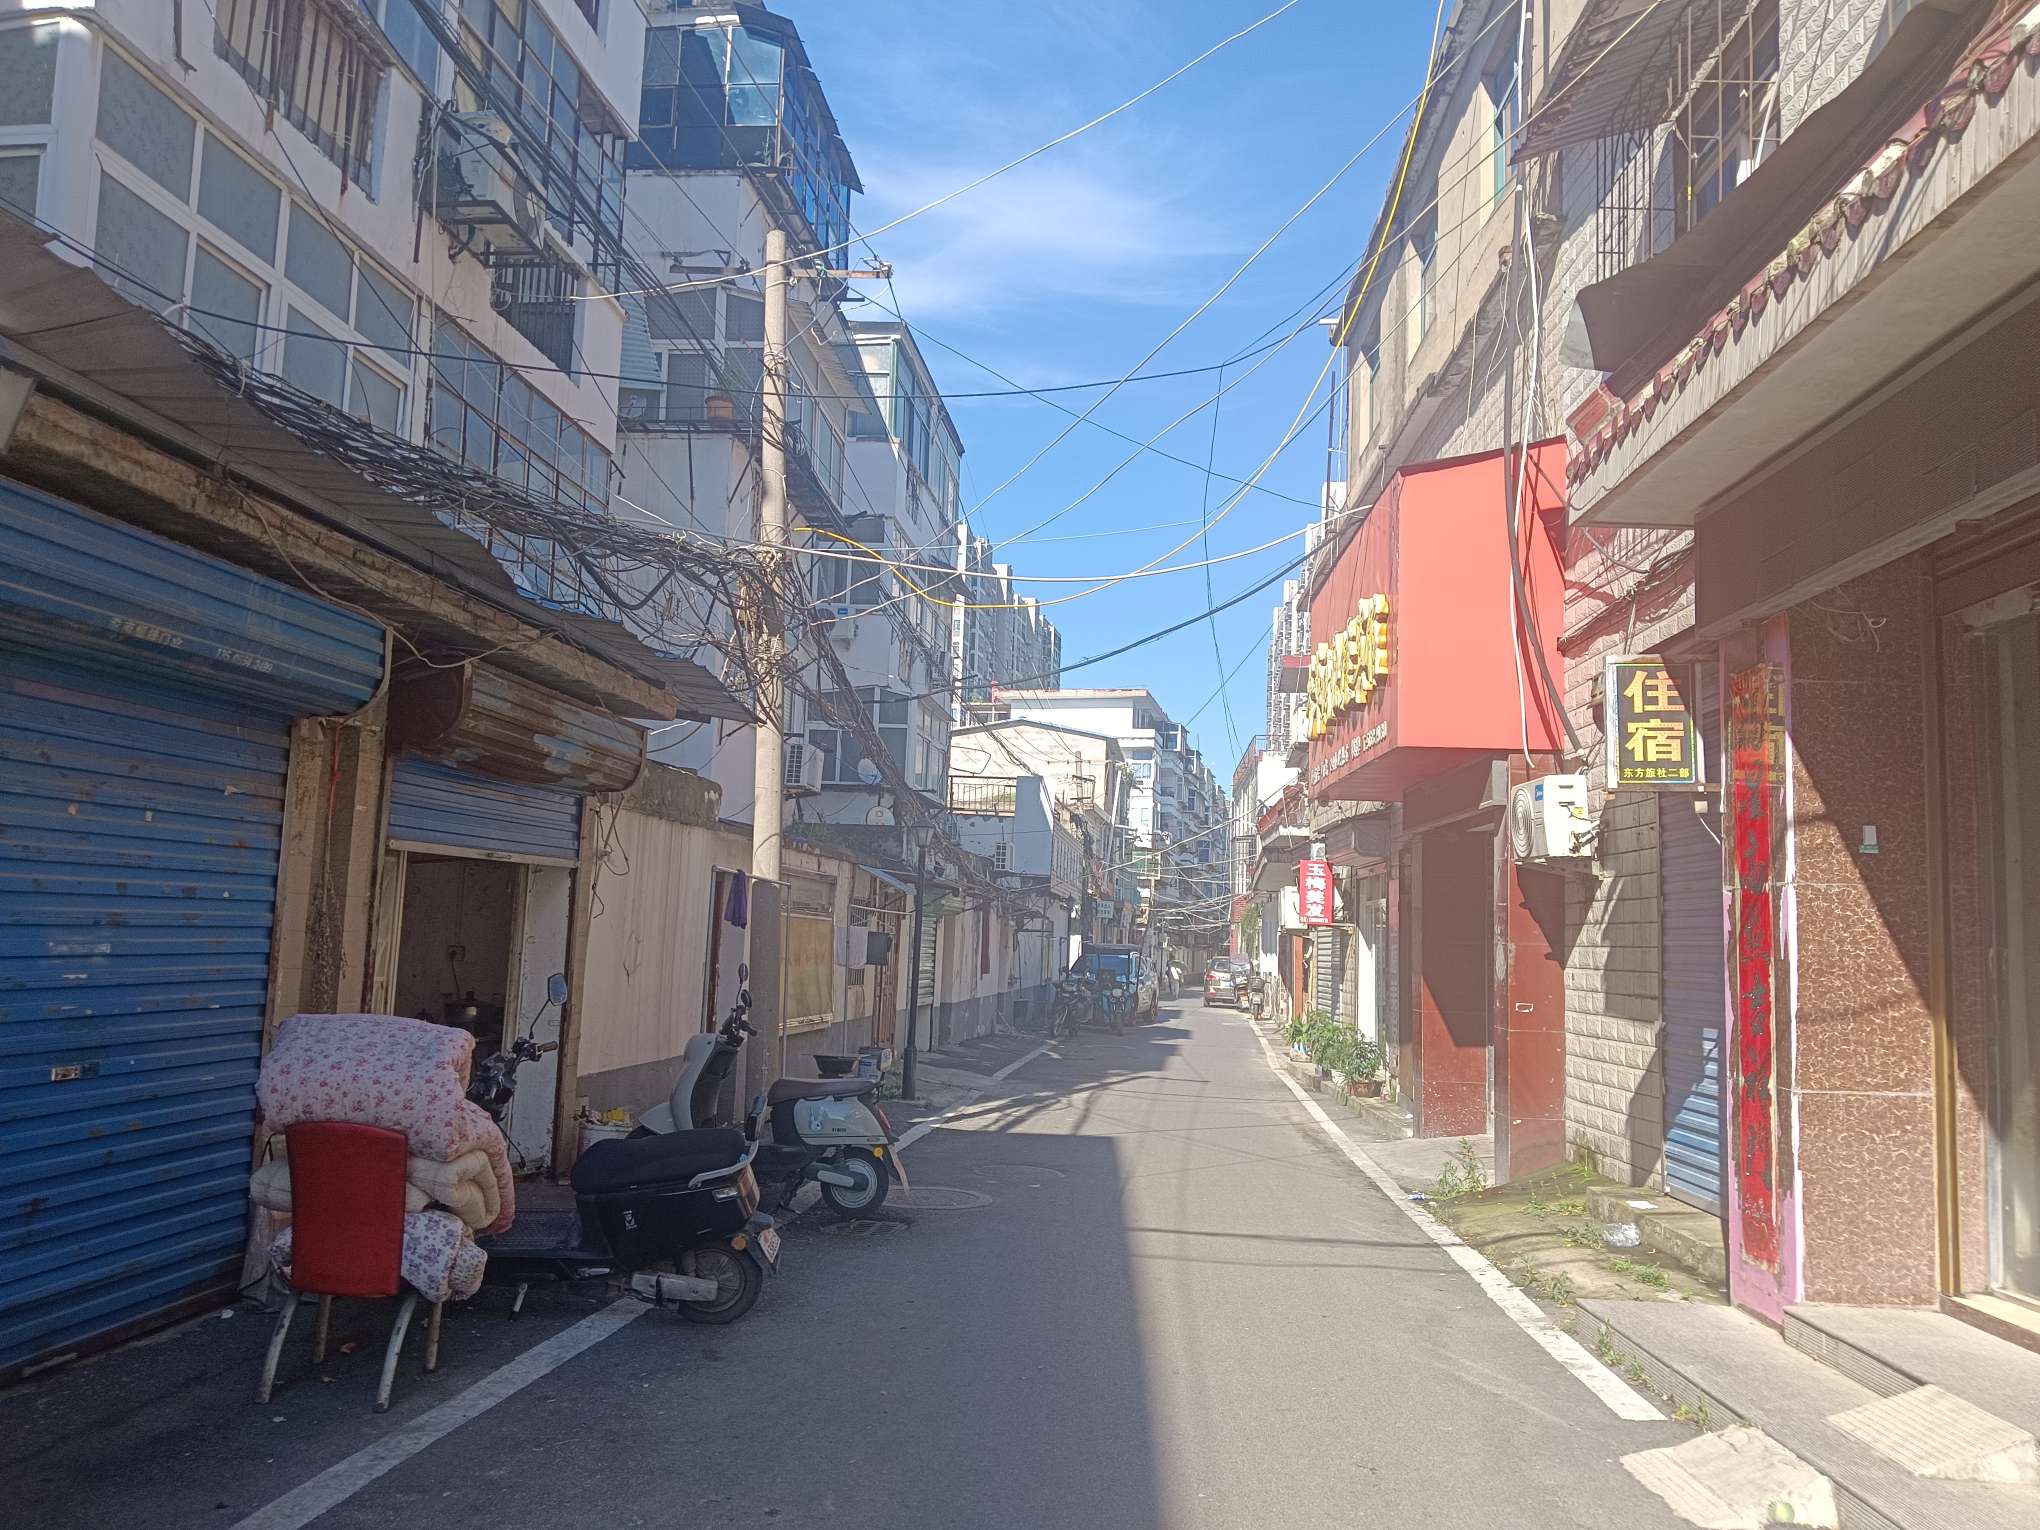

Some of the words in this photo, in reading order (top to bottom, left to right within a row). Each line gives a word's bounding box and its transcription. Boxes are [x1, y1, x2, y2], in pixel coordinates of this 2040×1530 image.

[1624, 670, 1686, 762] 住宿
[1623, 767, 1690, 778] 东方旅社二部
